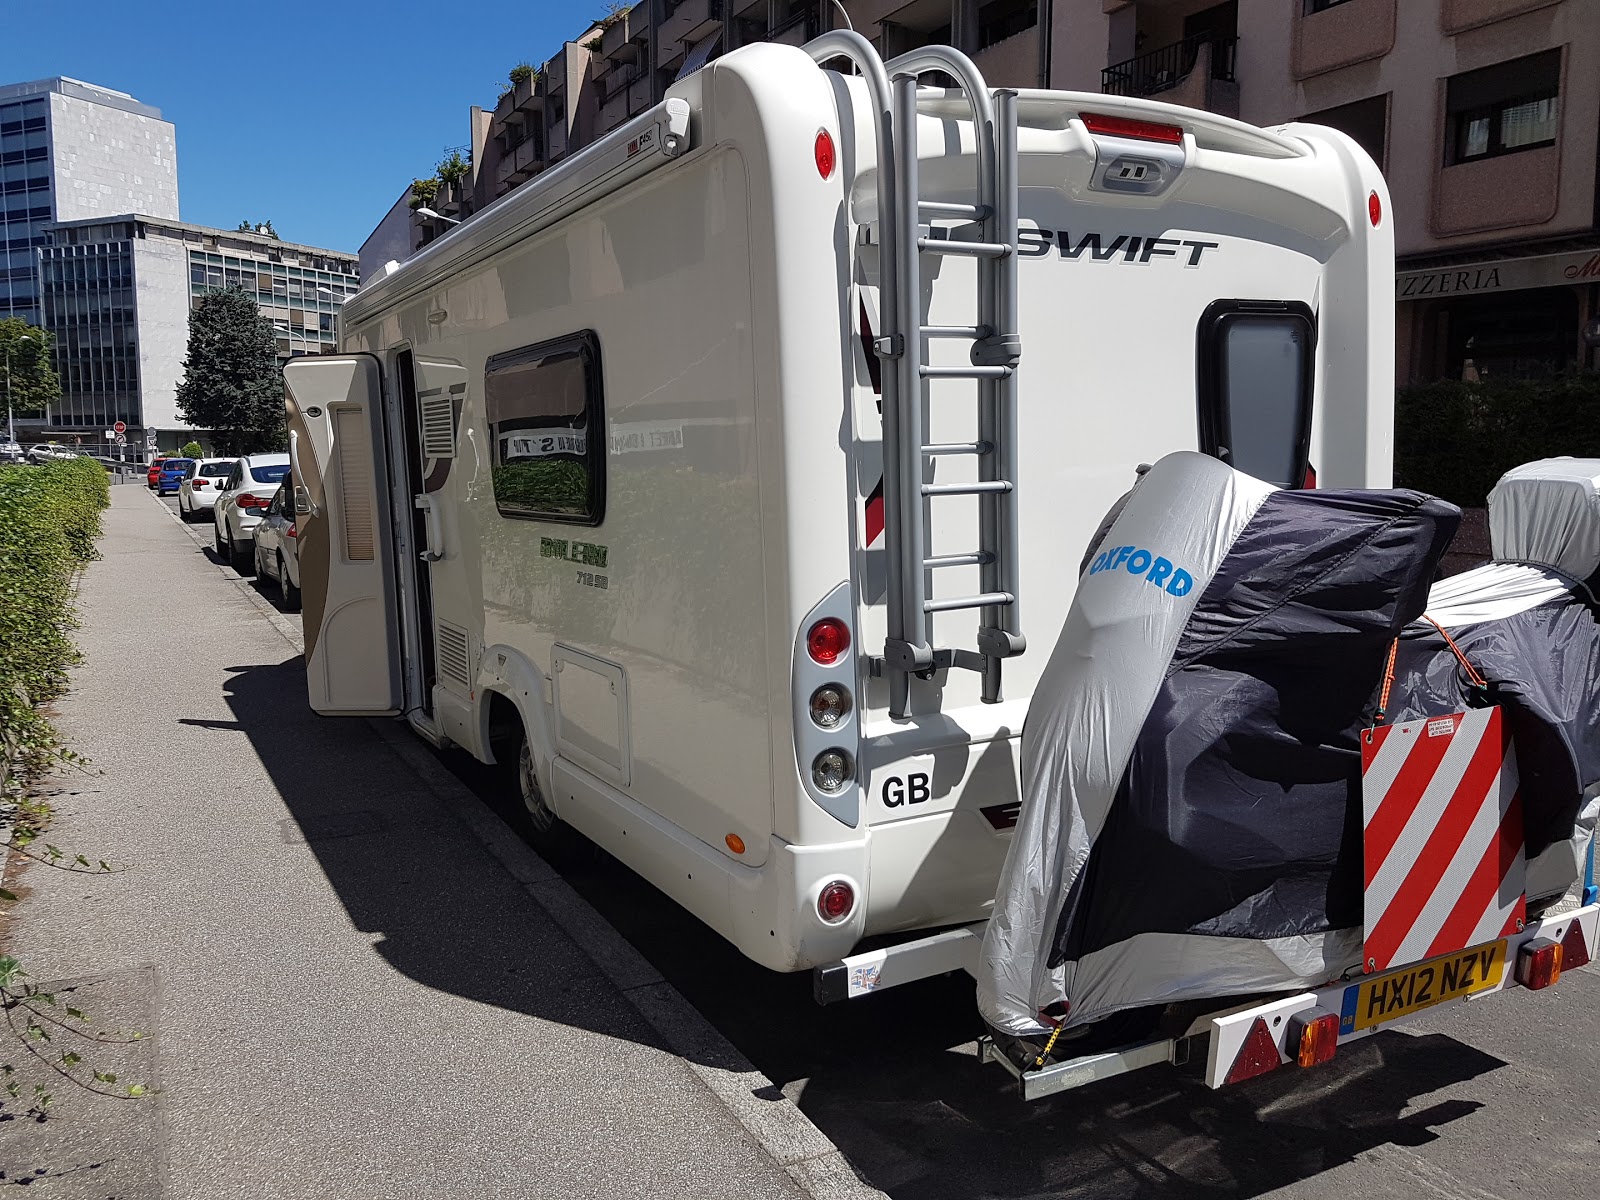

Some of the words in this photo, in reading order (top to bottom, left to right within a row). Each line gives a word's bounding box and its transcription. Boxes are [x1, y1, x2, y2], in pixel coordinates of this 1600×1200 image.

[1017, 228, 1219, 267] SWIFT
[1396, 267, 1501, 297] ZZERIA
[1089, 545, 1193, 597] OXFORD
[882, 772, 930, 808] GB
[1367, 967, 1435, 1019] HX12
[1440, 947, 1496, 996] NZV
